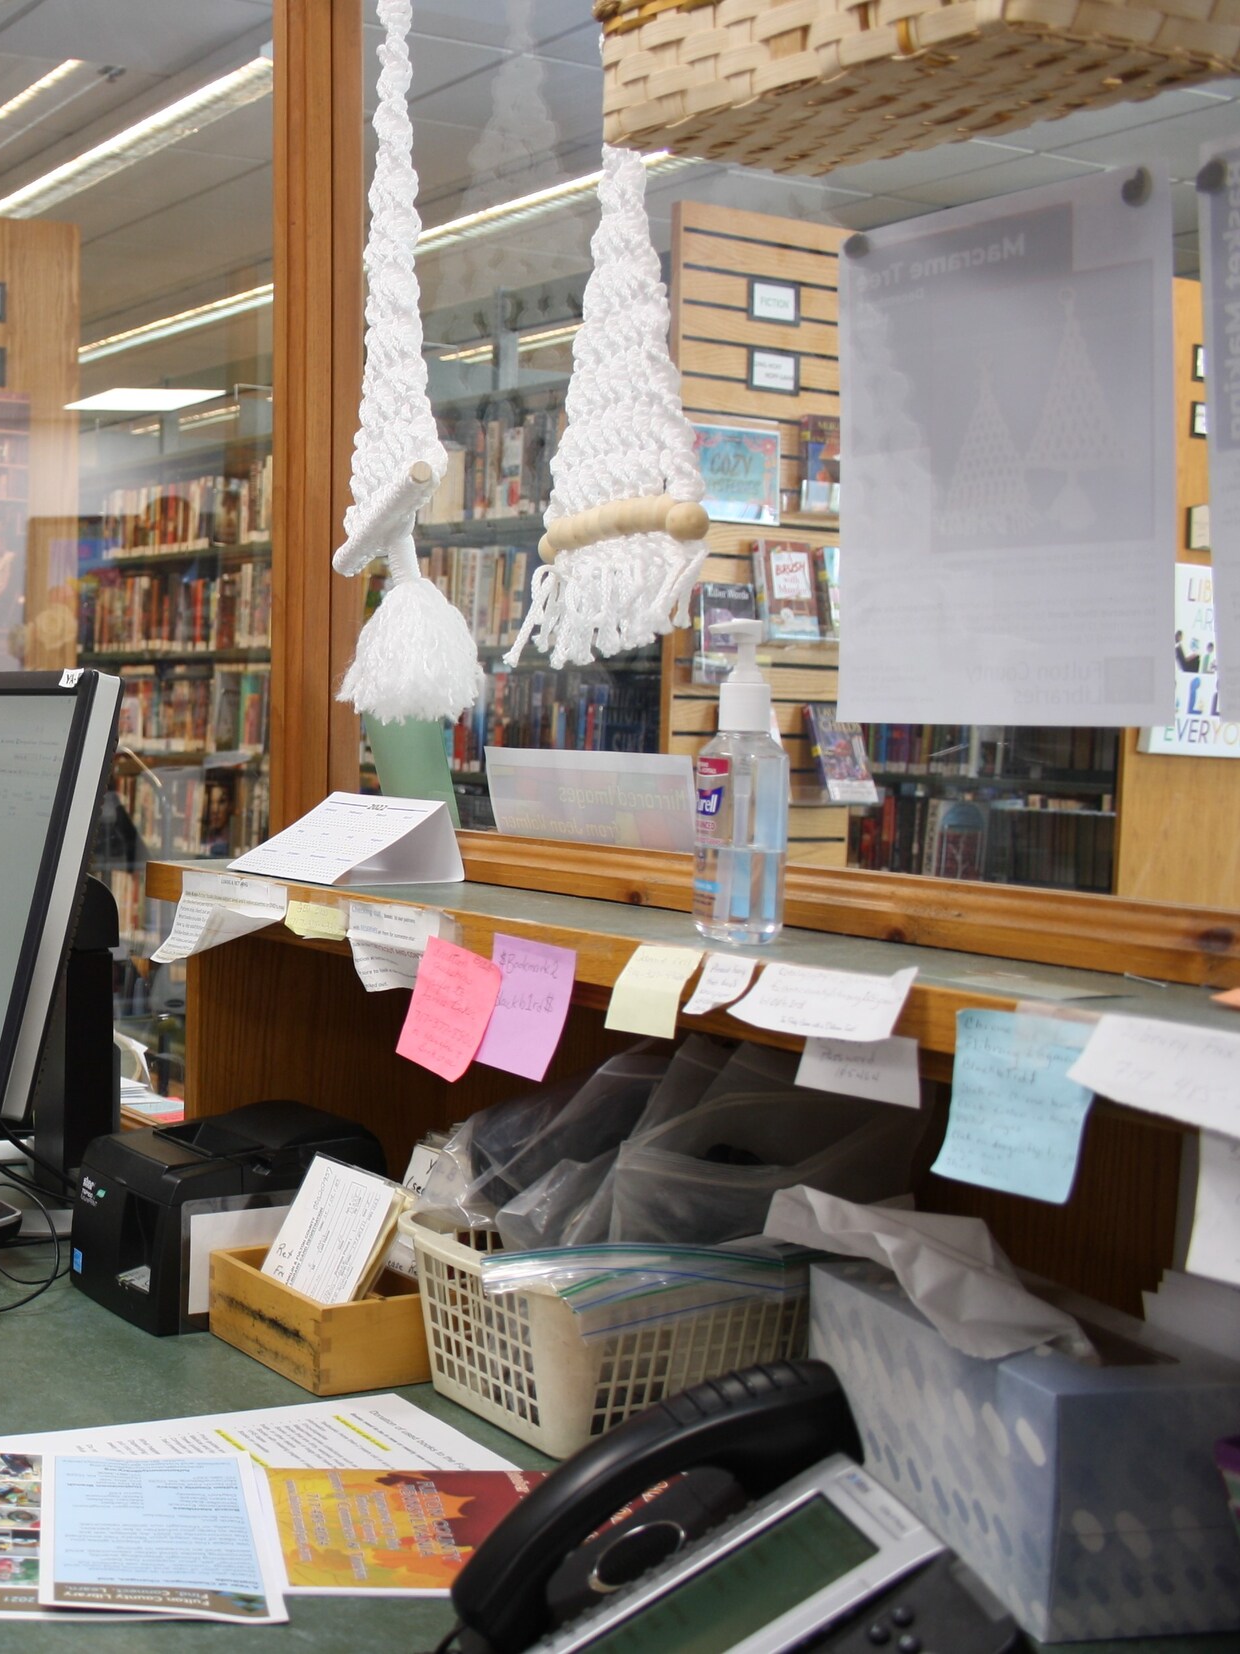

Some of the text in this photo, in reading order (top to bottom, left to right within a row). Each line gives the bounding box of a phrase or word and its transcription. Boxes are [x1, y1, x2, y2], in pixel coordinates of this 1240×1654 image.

[760, 296, 790, 310] FICTION
[711, 452, 753, 476] COZY
[775, 561, 805, 576] BRUSH
[726, 588, 750, 601] Words
[1187, 577, 1213, 602] LIB
[1192, 608, 1214, 631] AR
[1162, 719, 1240, 745] EVERYO
[367, 803, 388, 812] 2022
[368, 1409, 398, 1428] Donation
[401, 1430, 417, 1440] used
[415, 1435, 437, 1453] books
[443, 1453, 457, 1466] the
[396, 1482, 433, 1558] PENNSYLVANIA
[417, 1480, 462, 1562] FULTON COUNTY
[2, 1595, 36, 1604] 2021
[62, 1590, 210, 1606] Fulton County Library
[63, 1584, 209, 1599] Find. Connect. Learn.
